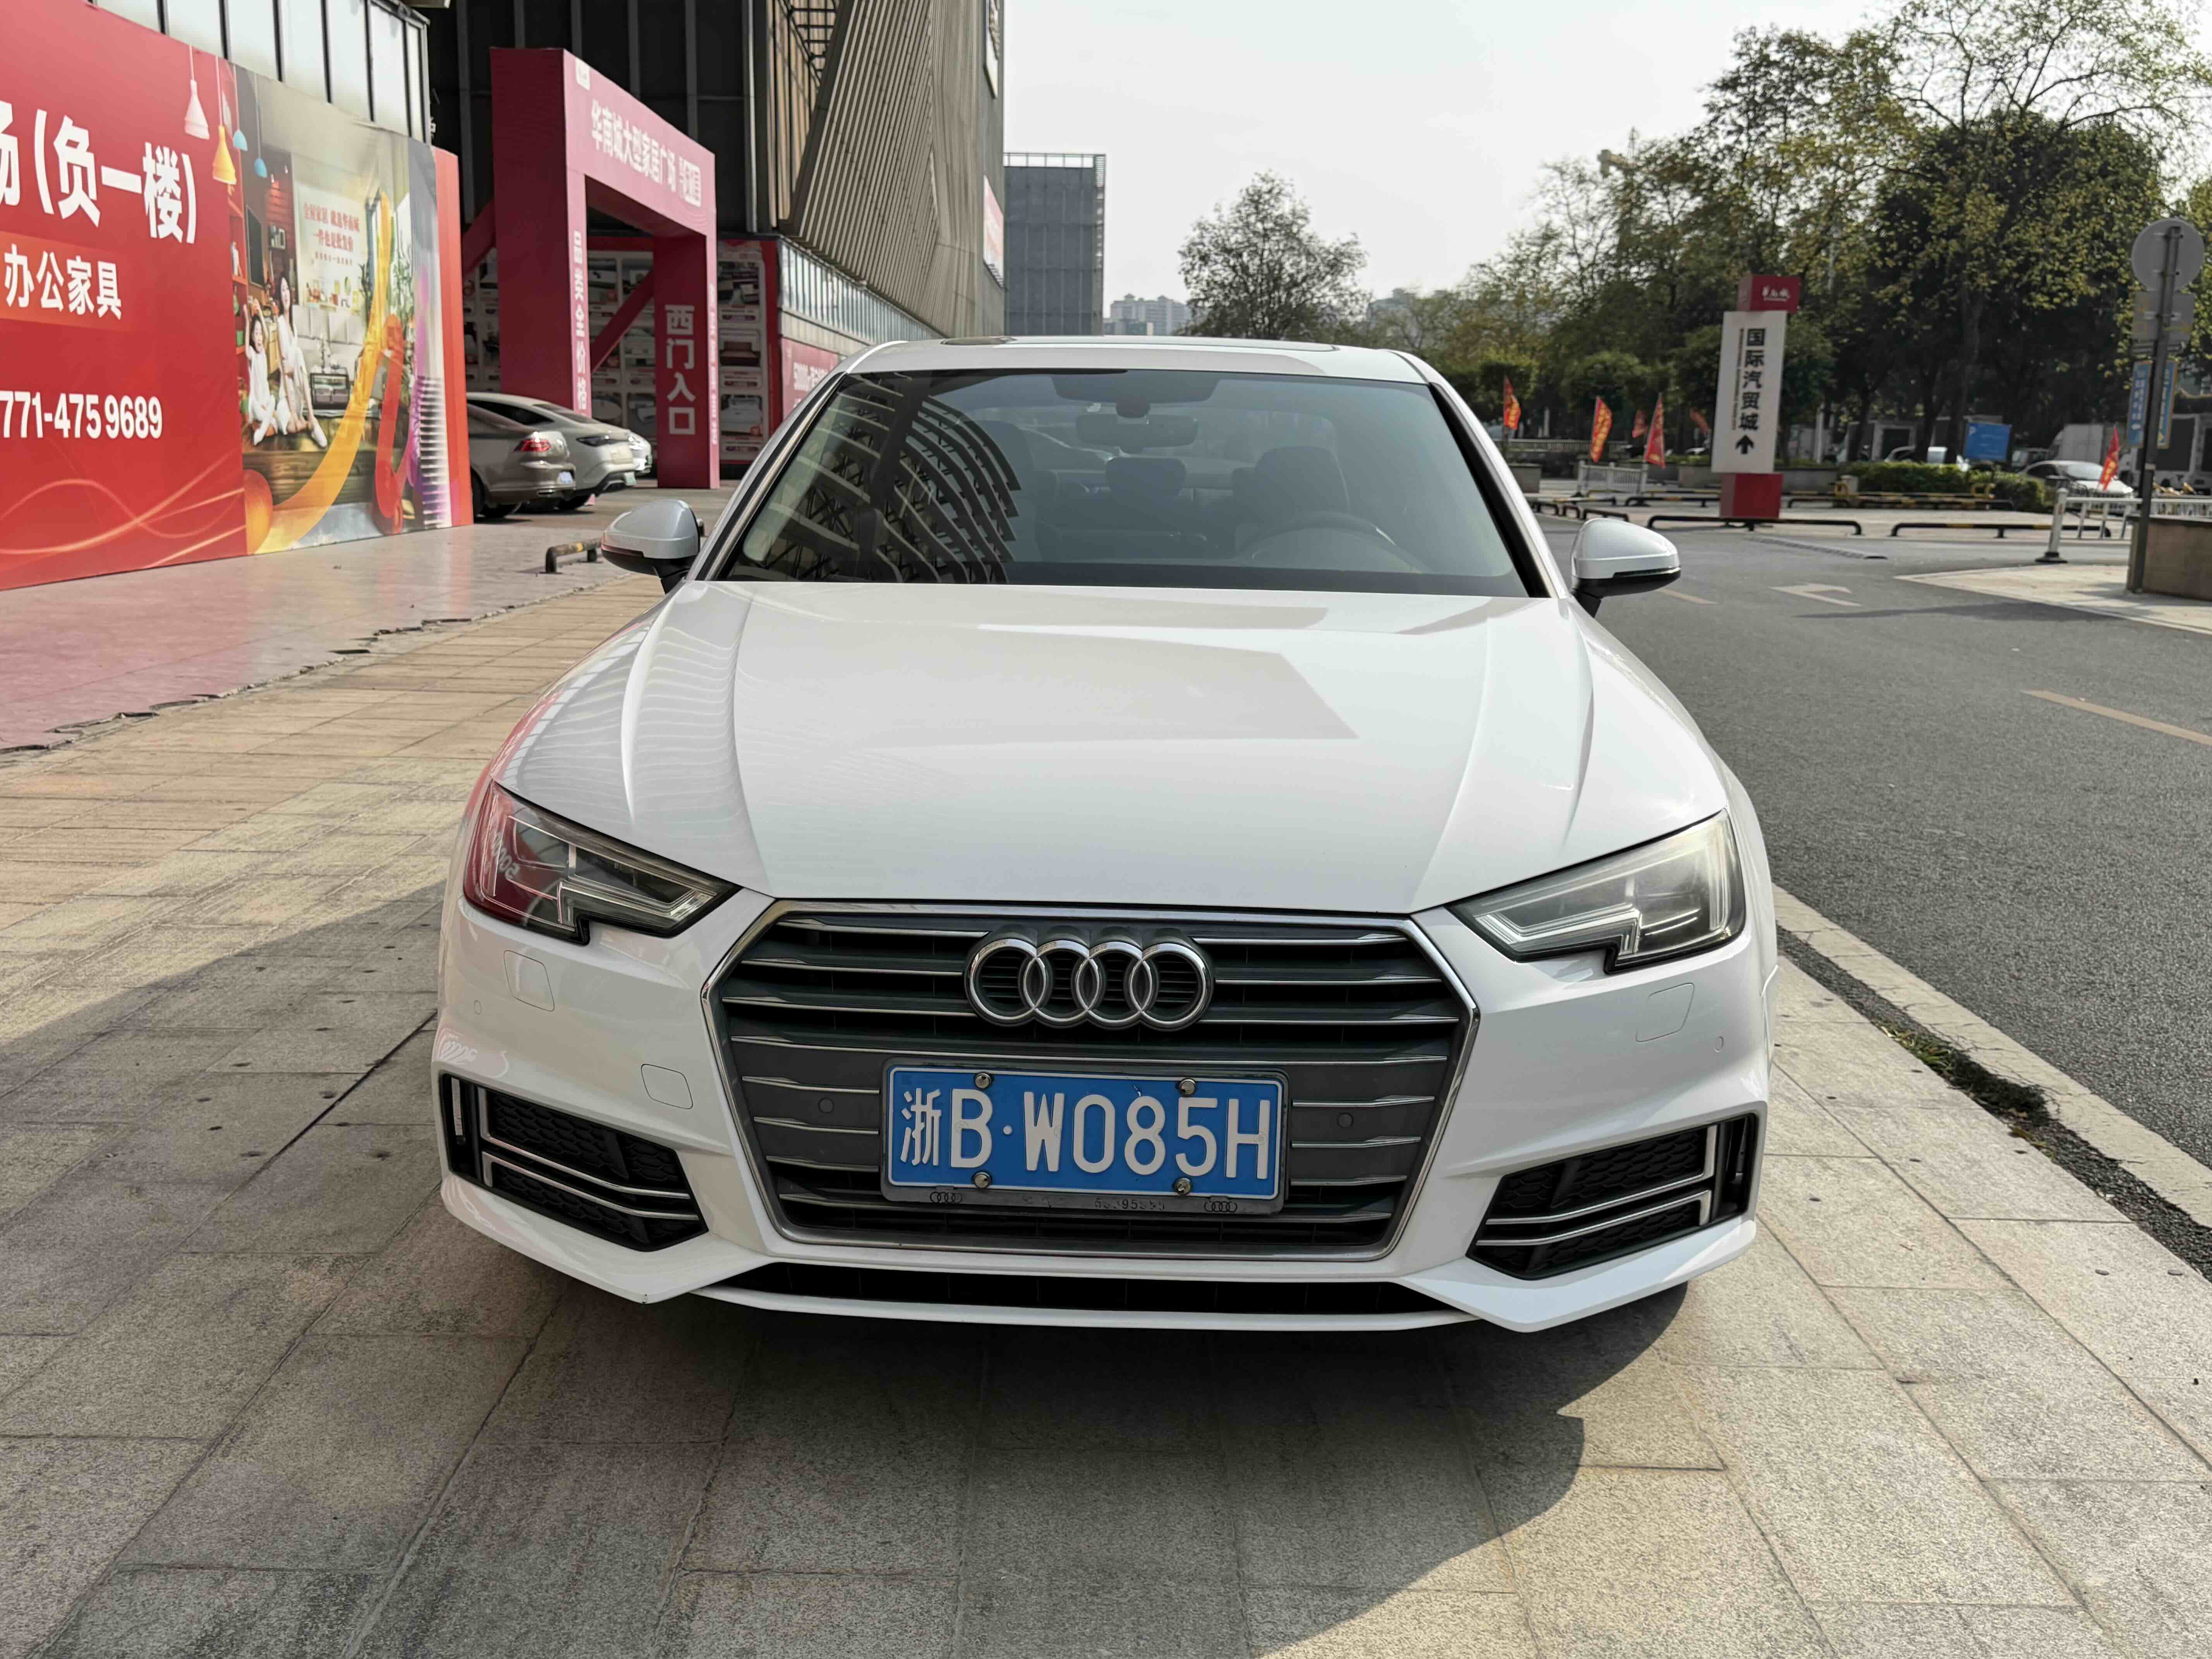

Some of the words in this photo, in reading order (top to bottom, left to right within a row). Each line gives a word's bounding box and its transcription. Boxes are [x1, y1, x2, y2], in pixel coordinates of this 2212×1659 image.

[4, 244, 122, 319] 办公家具
[665, 305, 696, 435] 西门入口
[1739, 328, 1766, 431] 国际汽贸城
